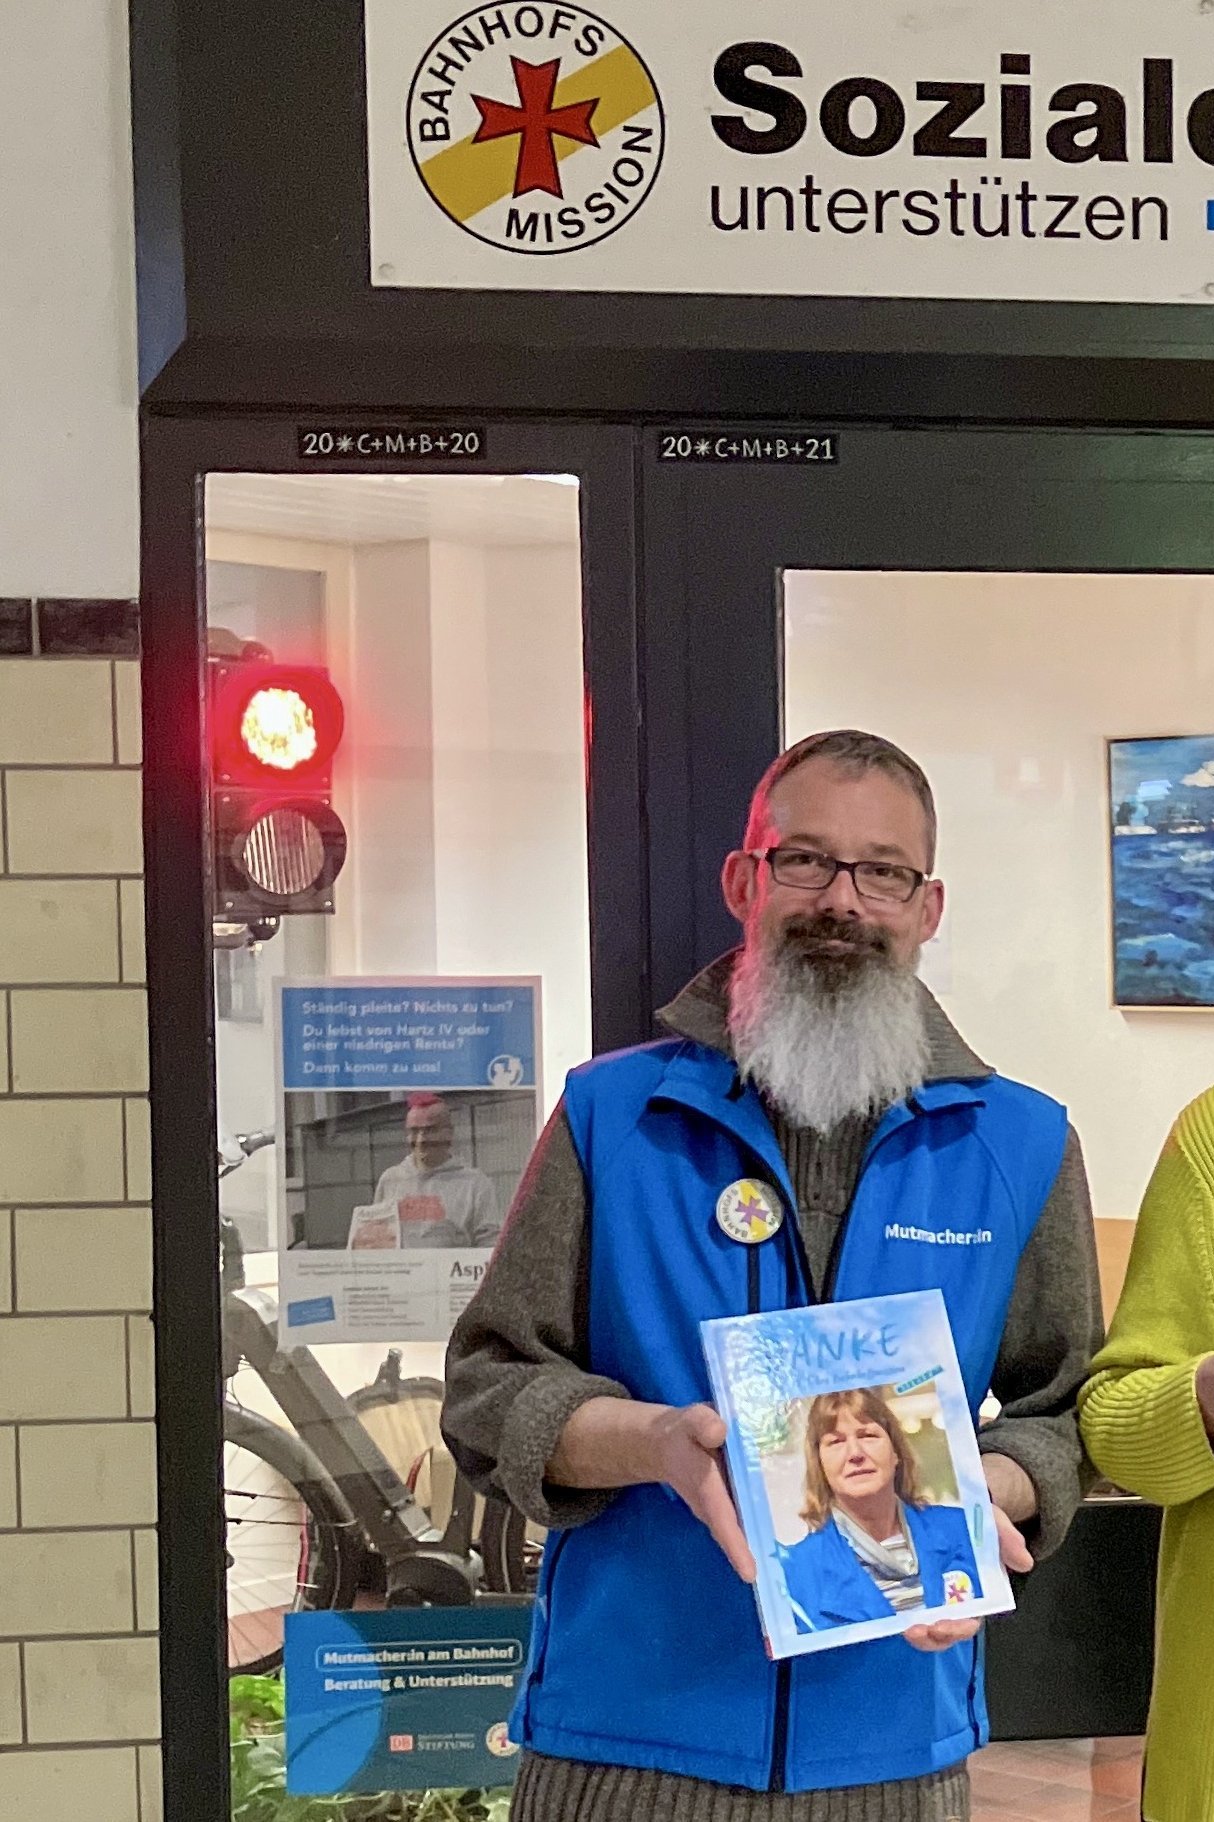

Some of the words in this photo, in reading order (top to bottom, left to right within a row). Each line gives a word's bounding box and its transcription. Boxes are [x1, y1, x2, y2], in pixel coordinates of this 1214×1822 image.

[419, 6, 605, 142] BAHNHOFS
[505, 125, 653, 243] MISSION
[711, 174, 1168, 241] unterstützen
[414, 1000, 458, 1014] Nichts
[303, 1024, 324, 1036] Du
[367, 1025, 392, 1036] von
[397, 1023, 434, 1037] Hartz
[439, 1023, 452, 1035] IV
[303, 1061, 340, 1074] Dann
[344, 1061, 388, 1074] komm
[392, 1062, 408, 1074] zu
[323, 1649, 425, 1665] Mutmacher:in
[427, 1650, 451, 1661] am
[453, 1646, 514, 1660] Bahnhof
[324, 1676, 391, 1692] Beratung
[393, 1676, 406, 1689] &
[409, 1673, 514, 1690] Unterstützung
